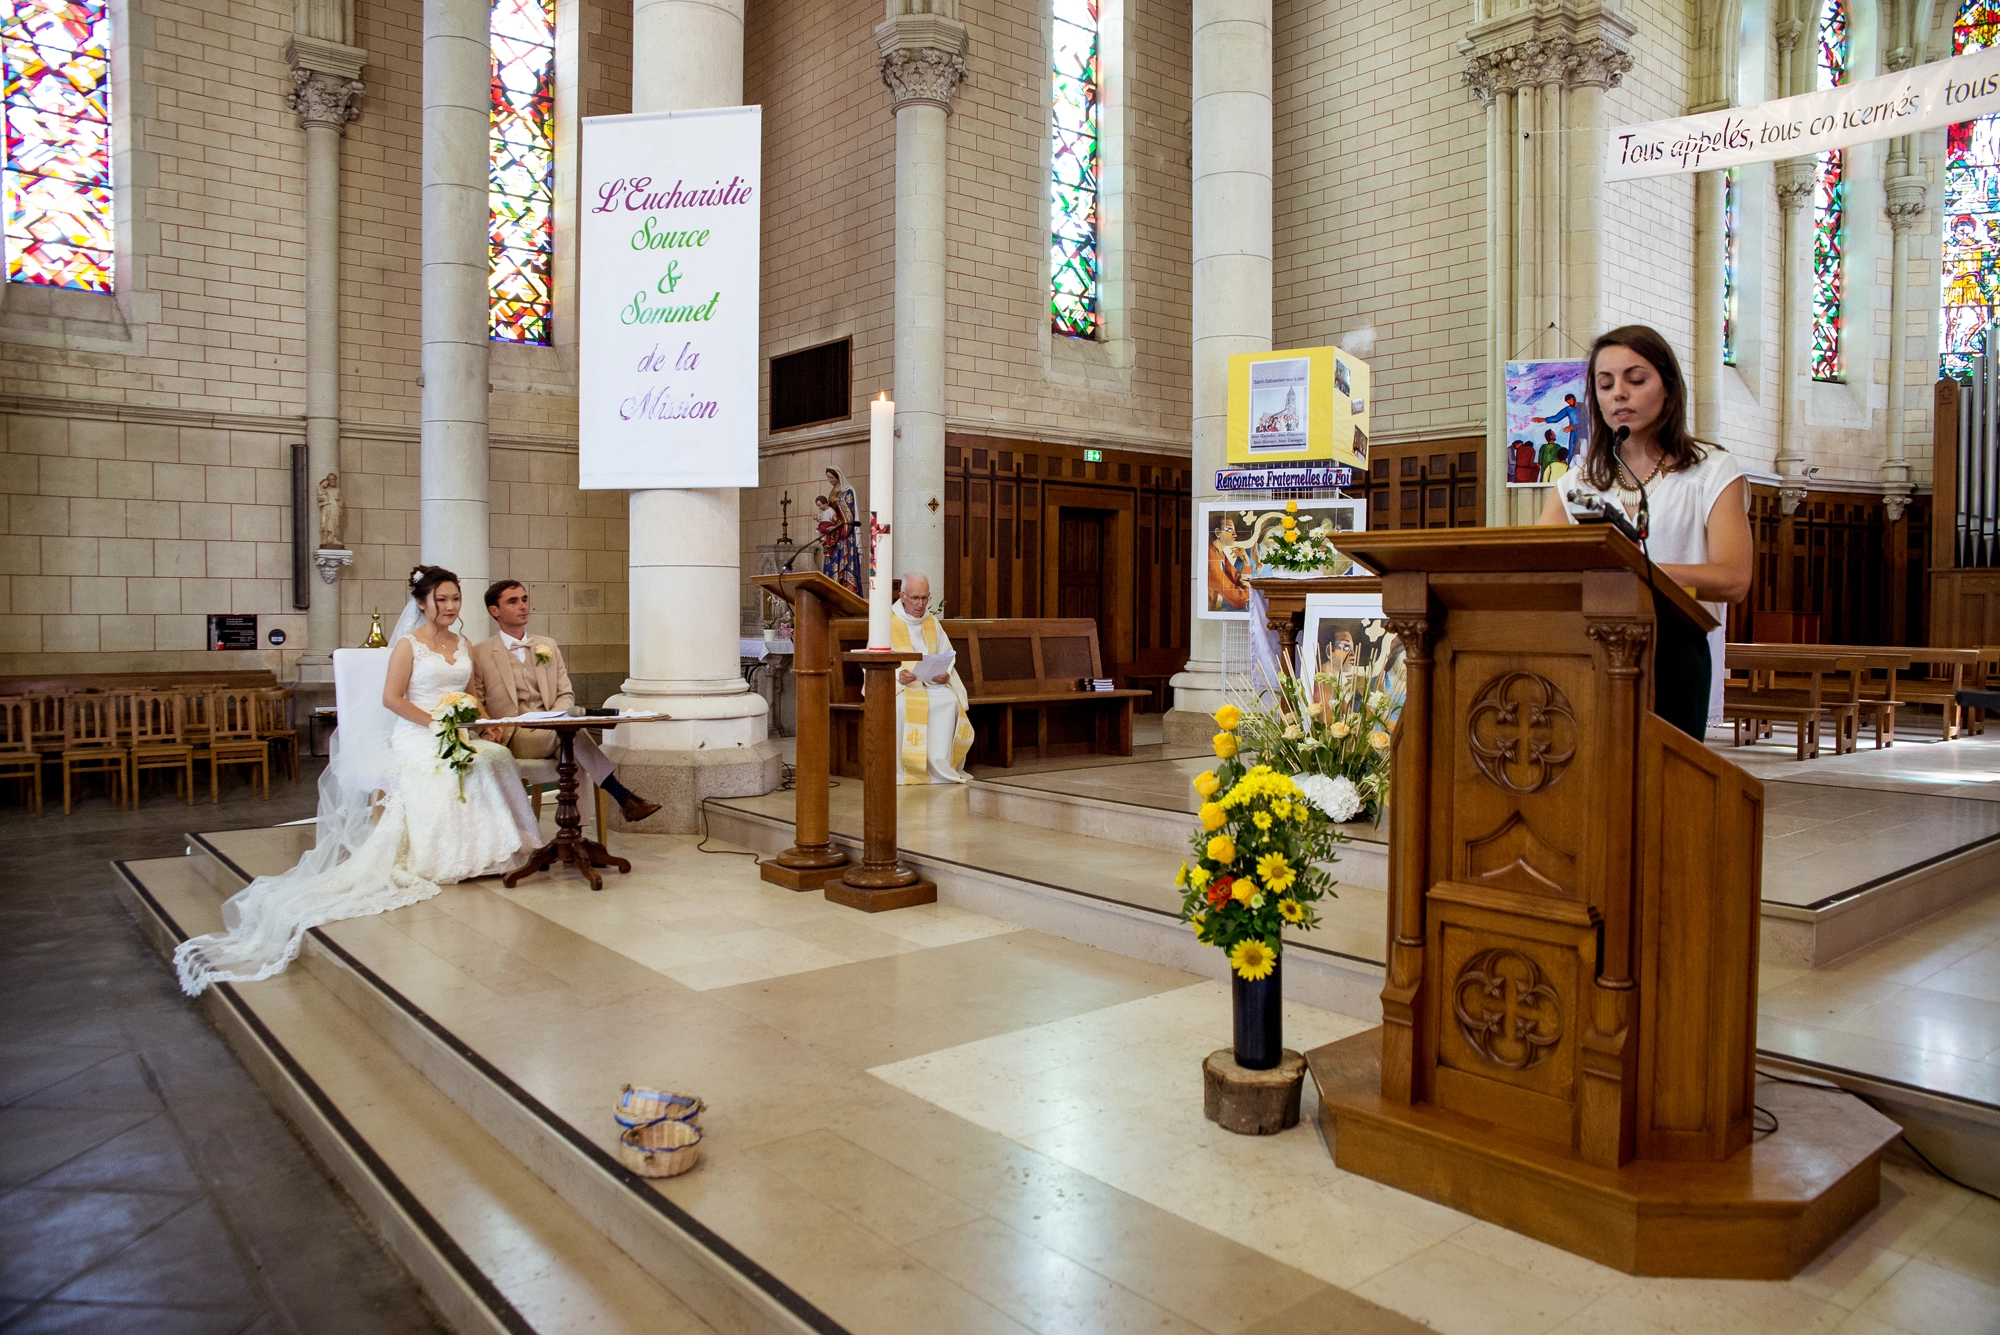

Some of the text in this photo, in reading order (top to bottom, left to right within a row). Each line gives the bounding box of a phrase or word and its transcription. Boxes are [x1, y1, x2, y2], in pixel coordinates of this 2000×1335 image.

[1618, 133, 1664, 165] Tous
[1670, 116, 1754, 169] appelés,
[1760, 121, 1803, 144] tous
[1944, 73, 1999, 106] tous
[591, 175, 753, 214] L'Eucharistie
[631, 216, 711, 251] Source
[657, 259, 683, 295] &
[620, 290, 721, 325] Sommet
[637, 341, 702, 373] de la
[619, 385, 720, 421] Mission
[1216, 468, 1351, 489] Rencontres Fraternelles de Foi
